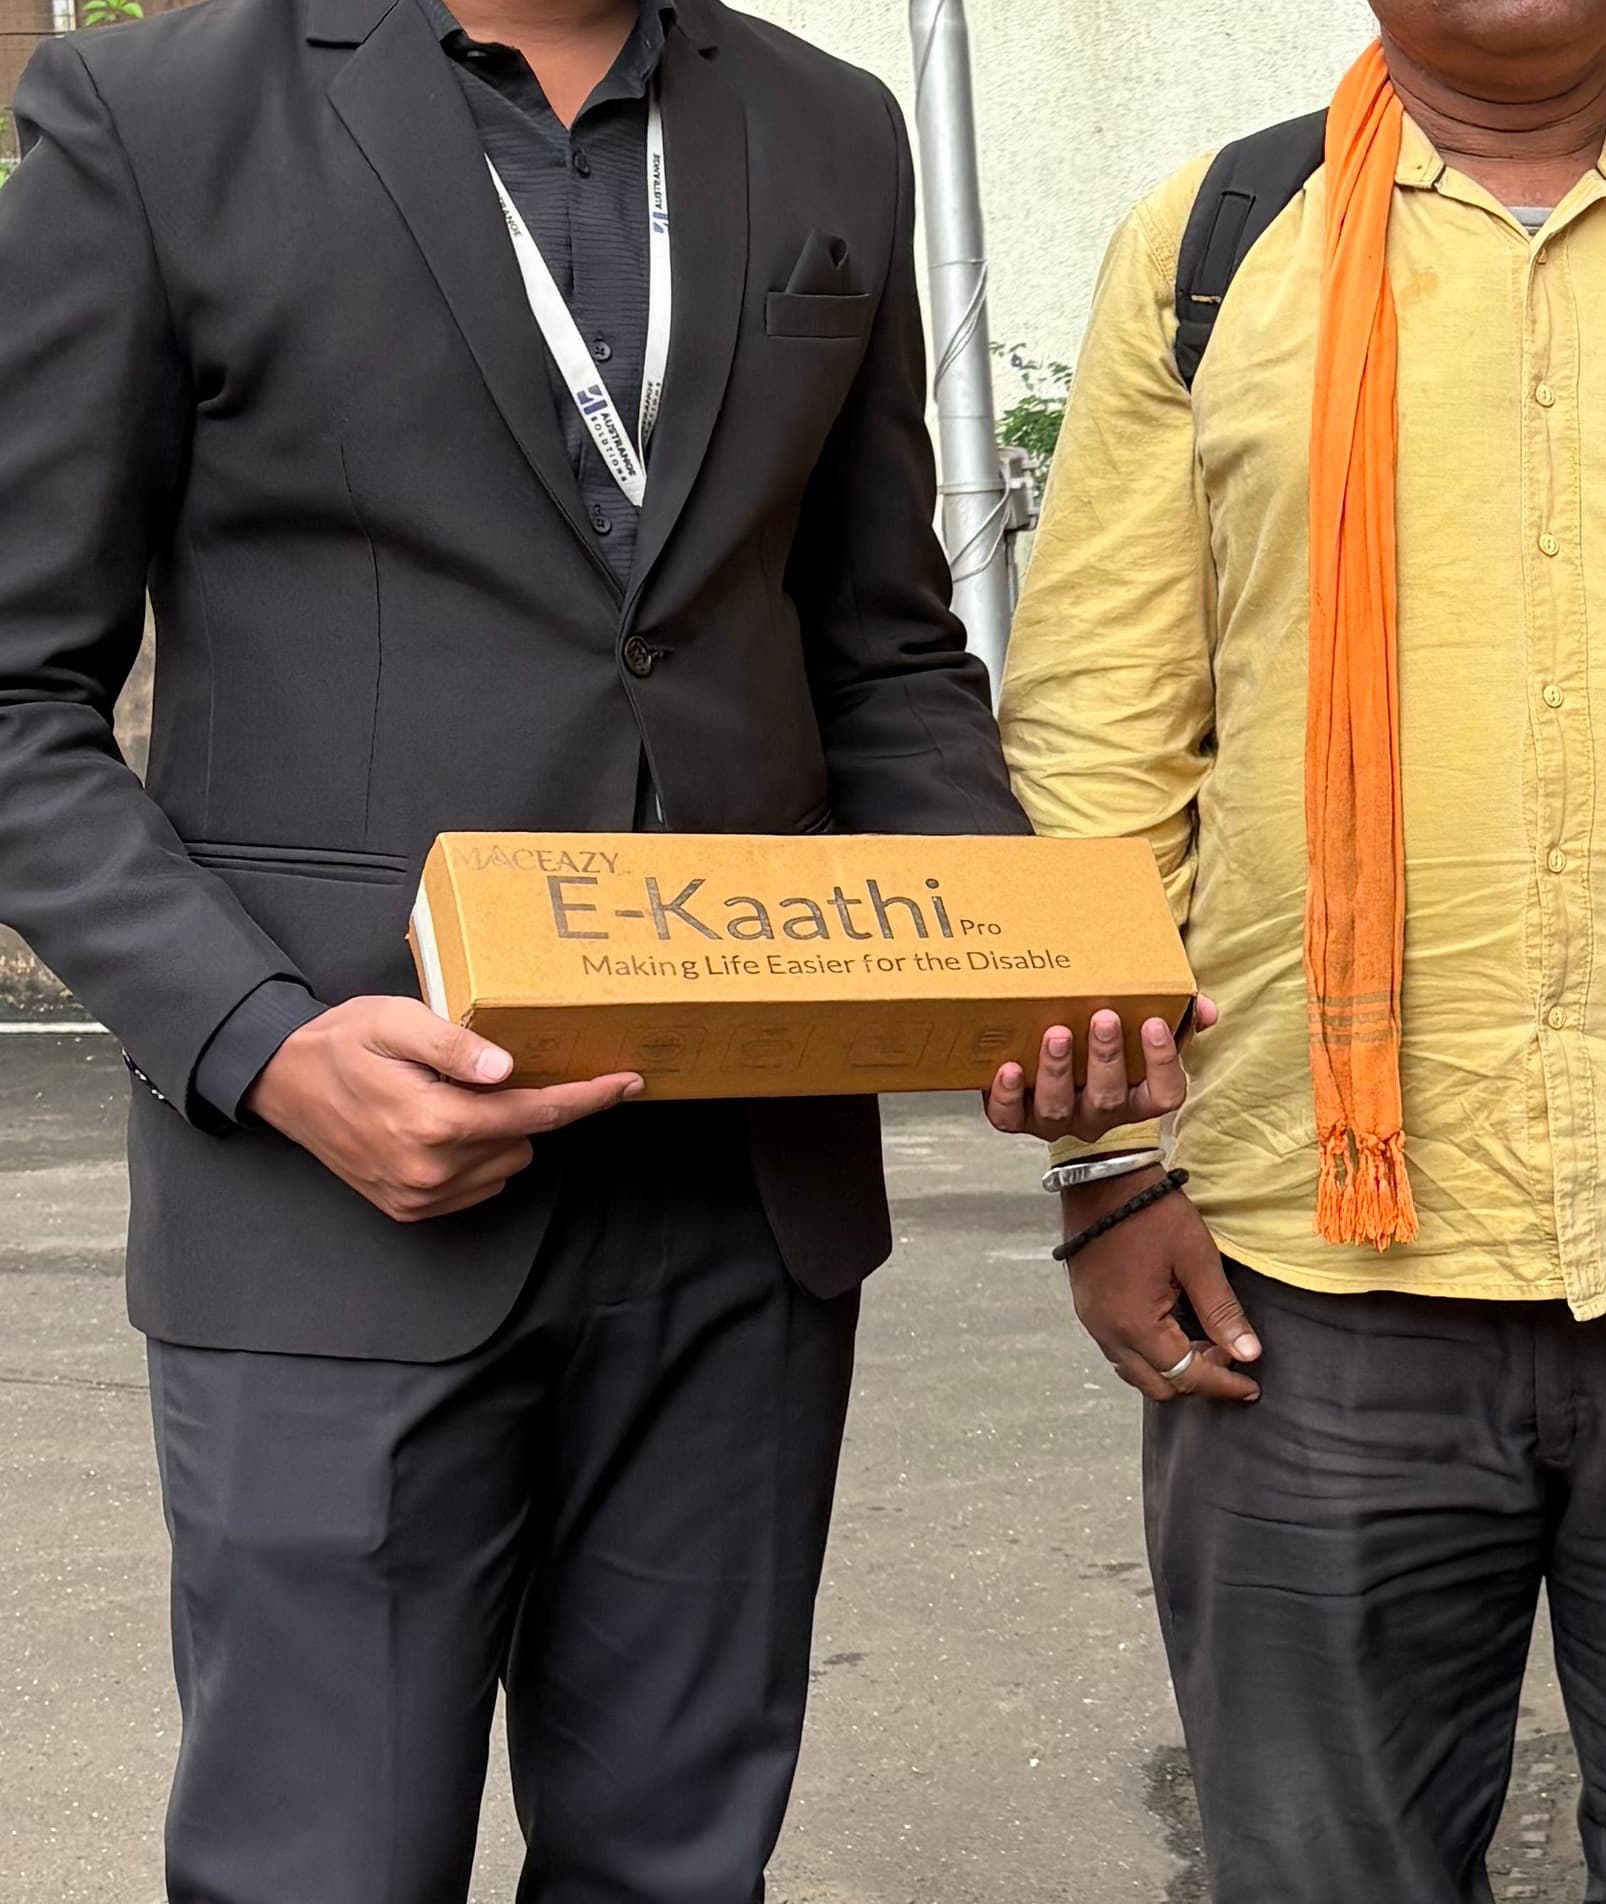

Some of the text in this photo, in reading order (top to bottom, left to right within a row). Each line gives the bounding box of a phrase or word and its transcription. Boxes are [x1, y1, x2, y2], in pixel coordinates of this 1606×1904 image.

[601, 412, 637, 477] AUSTRANGE
[452, 845, 619, 875] MACEAZY
[547, 875, 1002, 942] E-Kaathi Pro
[582, 949, 1072, 980] Making Life Easier for the Disable
